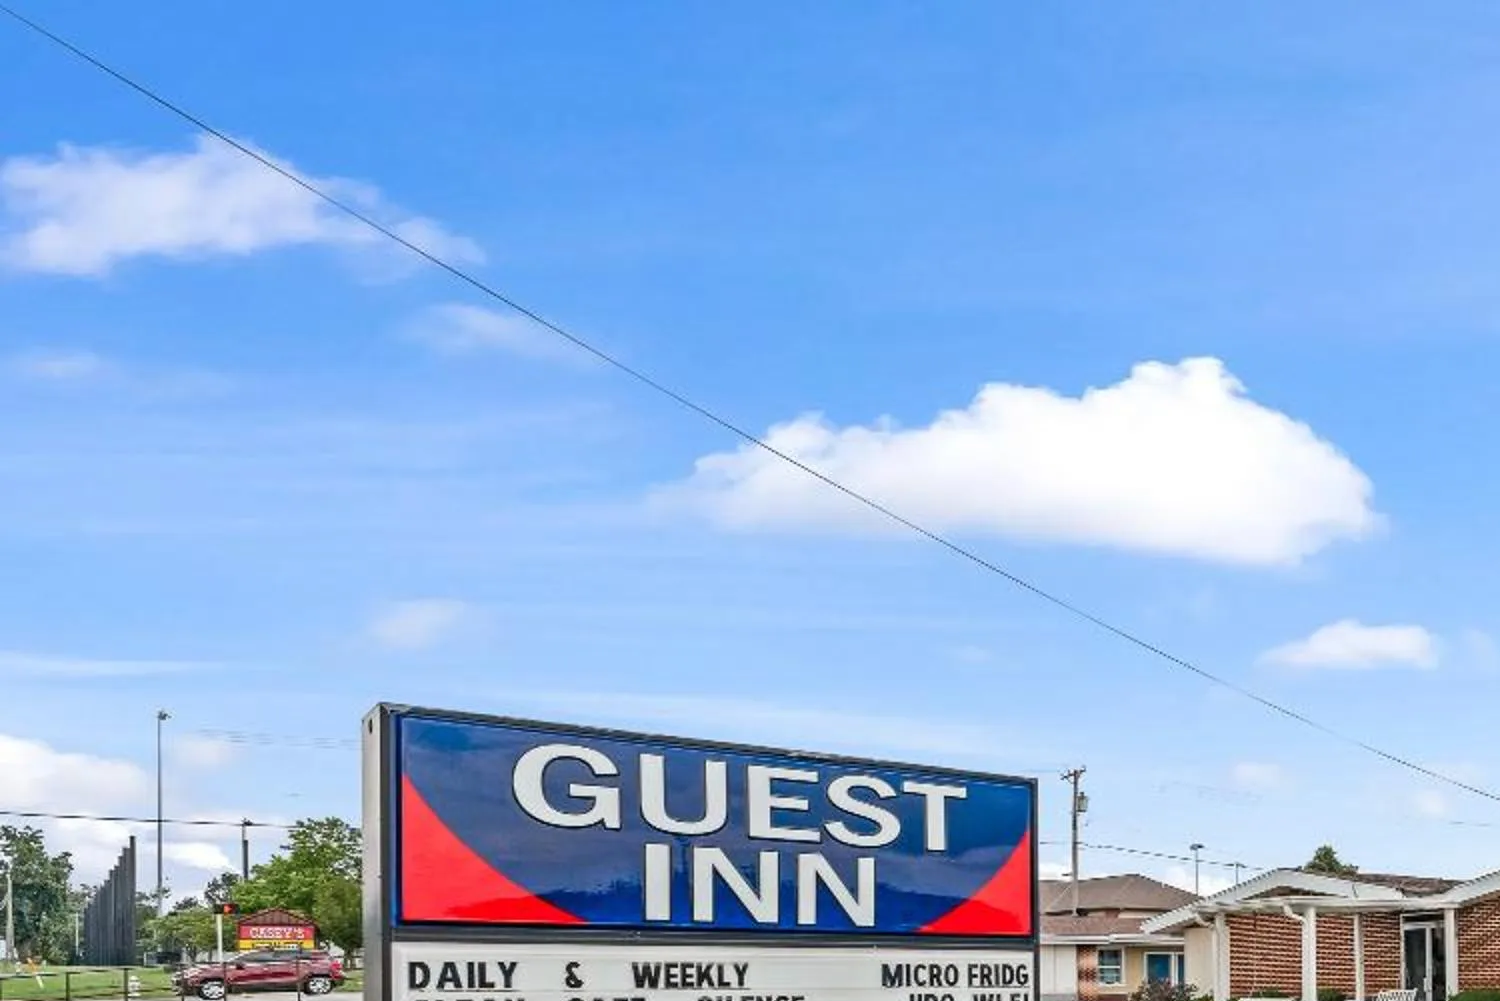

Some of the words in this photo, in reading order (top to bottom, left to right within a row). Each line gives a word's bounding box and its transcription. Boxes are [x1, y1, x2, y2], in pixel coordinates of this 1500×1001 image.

[513, 744, 967, 852] GUEST
[644, 843, 876, 927] INN
[408, 961, 518, 989] DAILY
[565, 962, 584, 988] &
[632, 962, 749, 988] WEEKLY
[881, 963, 959, 987] MICRO
[967, 964, 1028, 987] FRIDG
